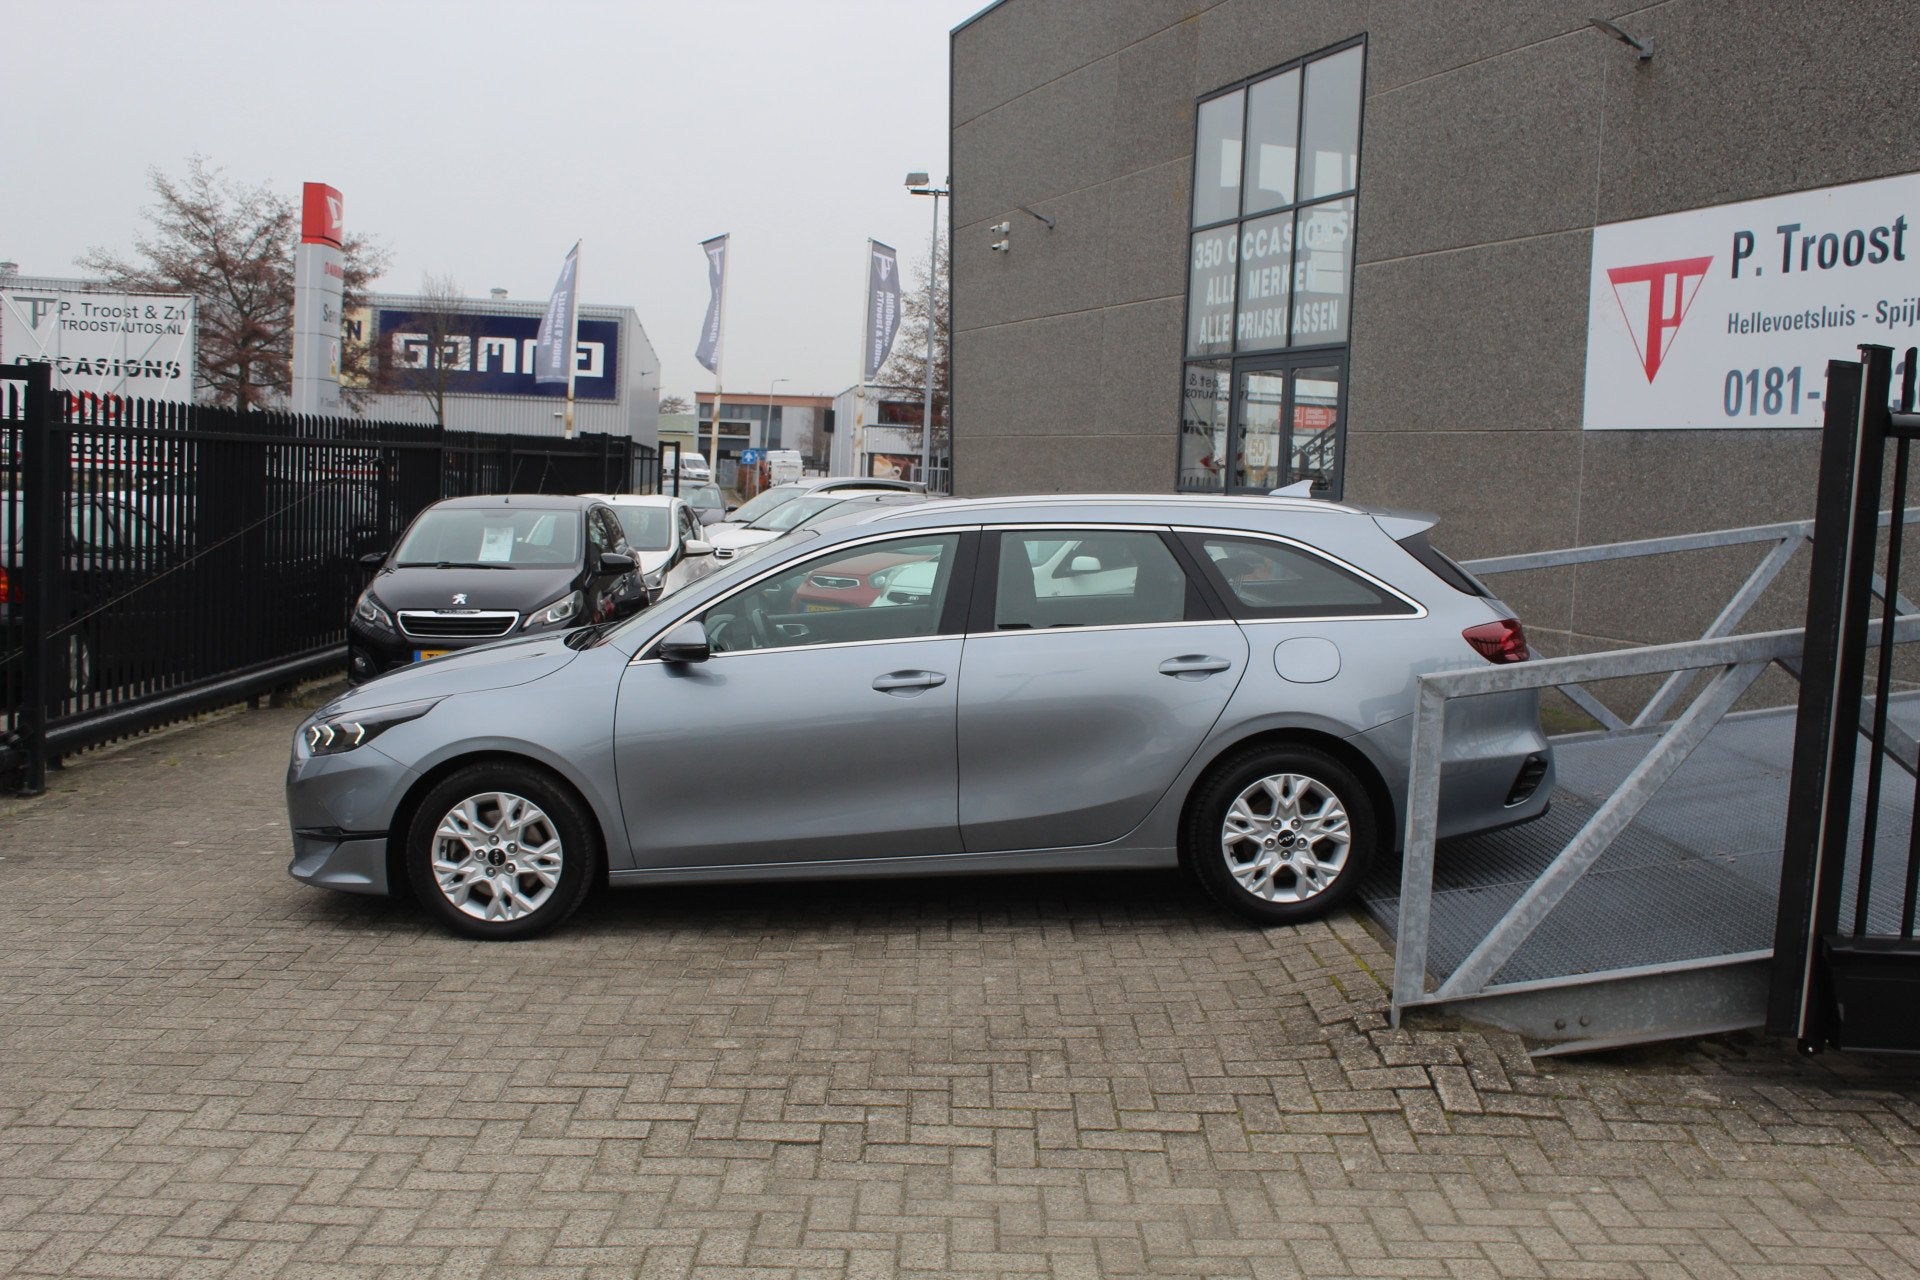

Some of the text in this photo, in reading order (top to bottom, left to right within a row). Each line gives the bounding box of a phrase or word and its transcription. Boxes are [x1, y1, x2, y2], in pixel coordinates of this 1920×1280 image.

[1195, 238, 1222, 270] 350
[1731, 214, 1908, 279] P. Troost
[1248, 260, 1320, 300] MERKE
[59, 301, 76, 317] P.
[81, 302, 139, 319] Troost
[144, 305, 158, 320] &
[1727, 303, 1856, 334] Hellevoetsluis
[1875, 297, 1920, 330] Spij
[61, 319, 186, 336] TROOSTAUTOS.NL
[1200, 313, 1230, 345] ALLE
[15, 354, 181, 379] OCASIONS
[1723, 366, 1828, 418] 0181-
